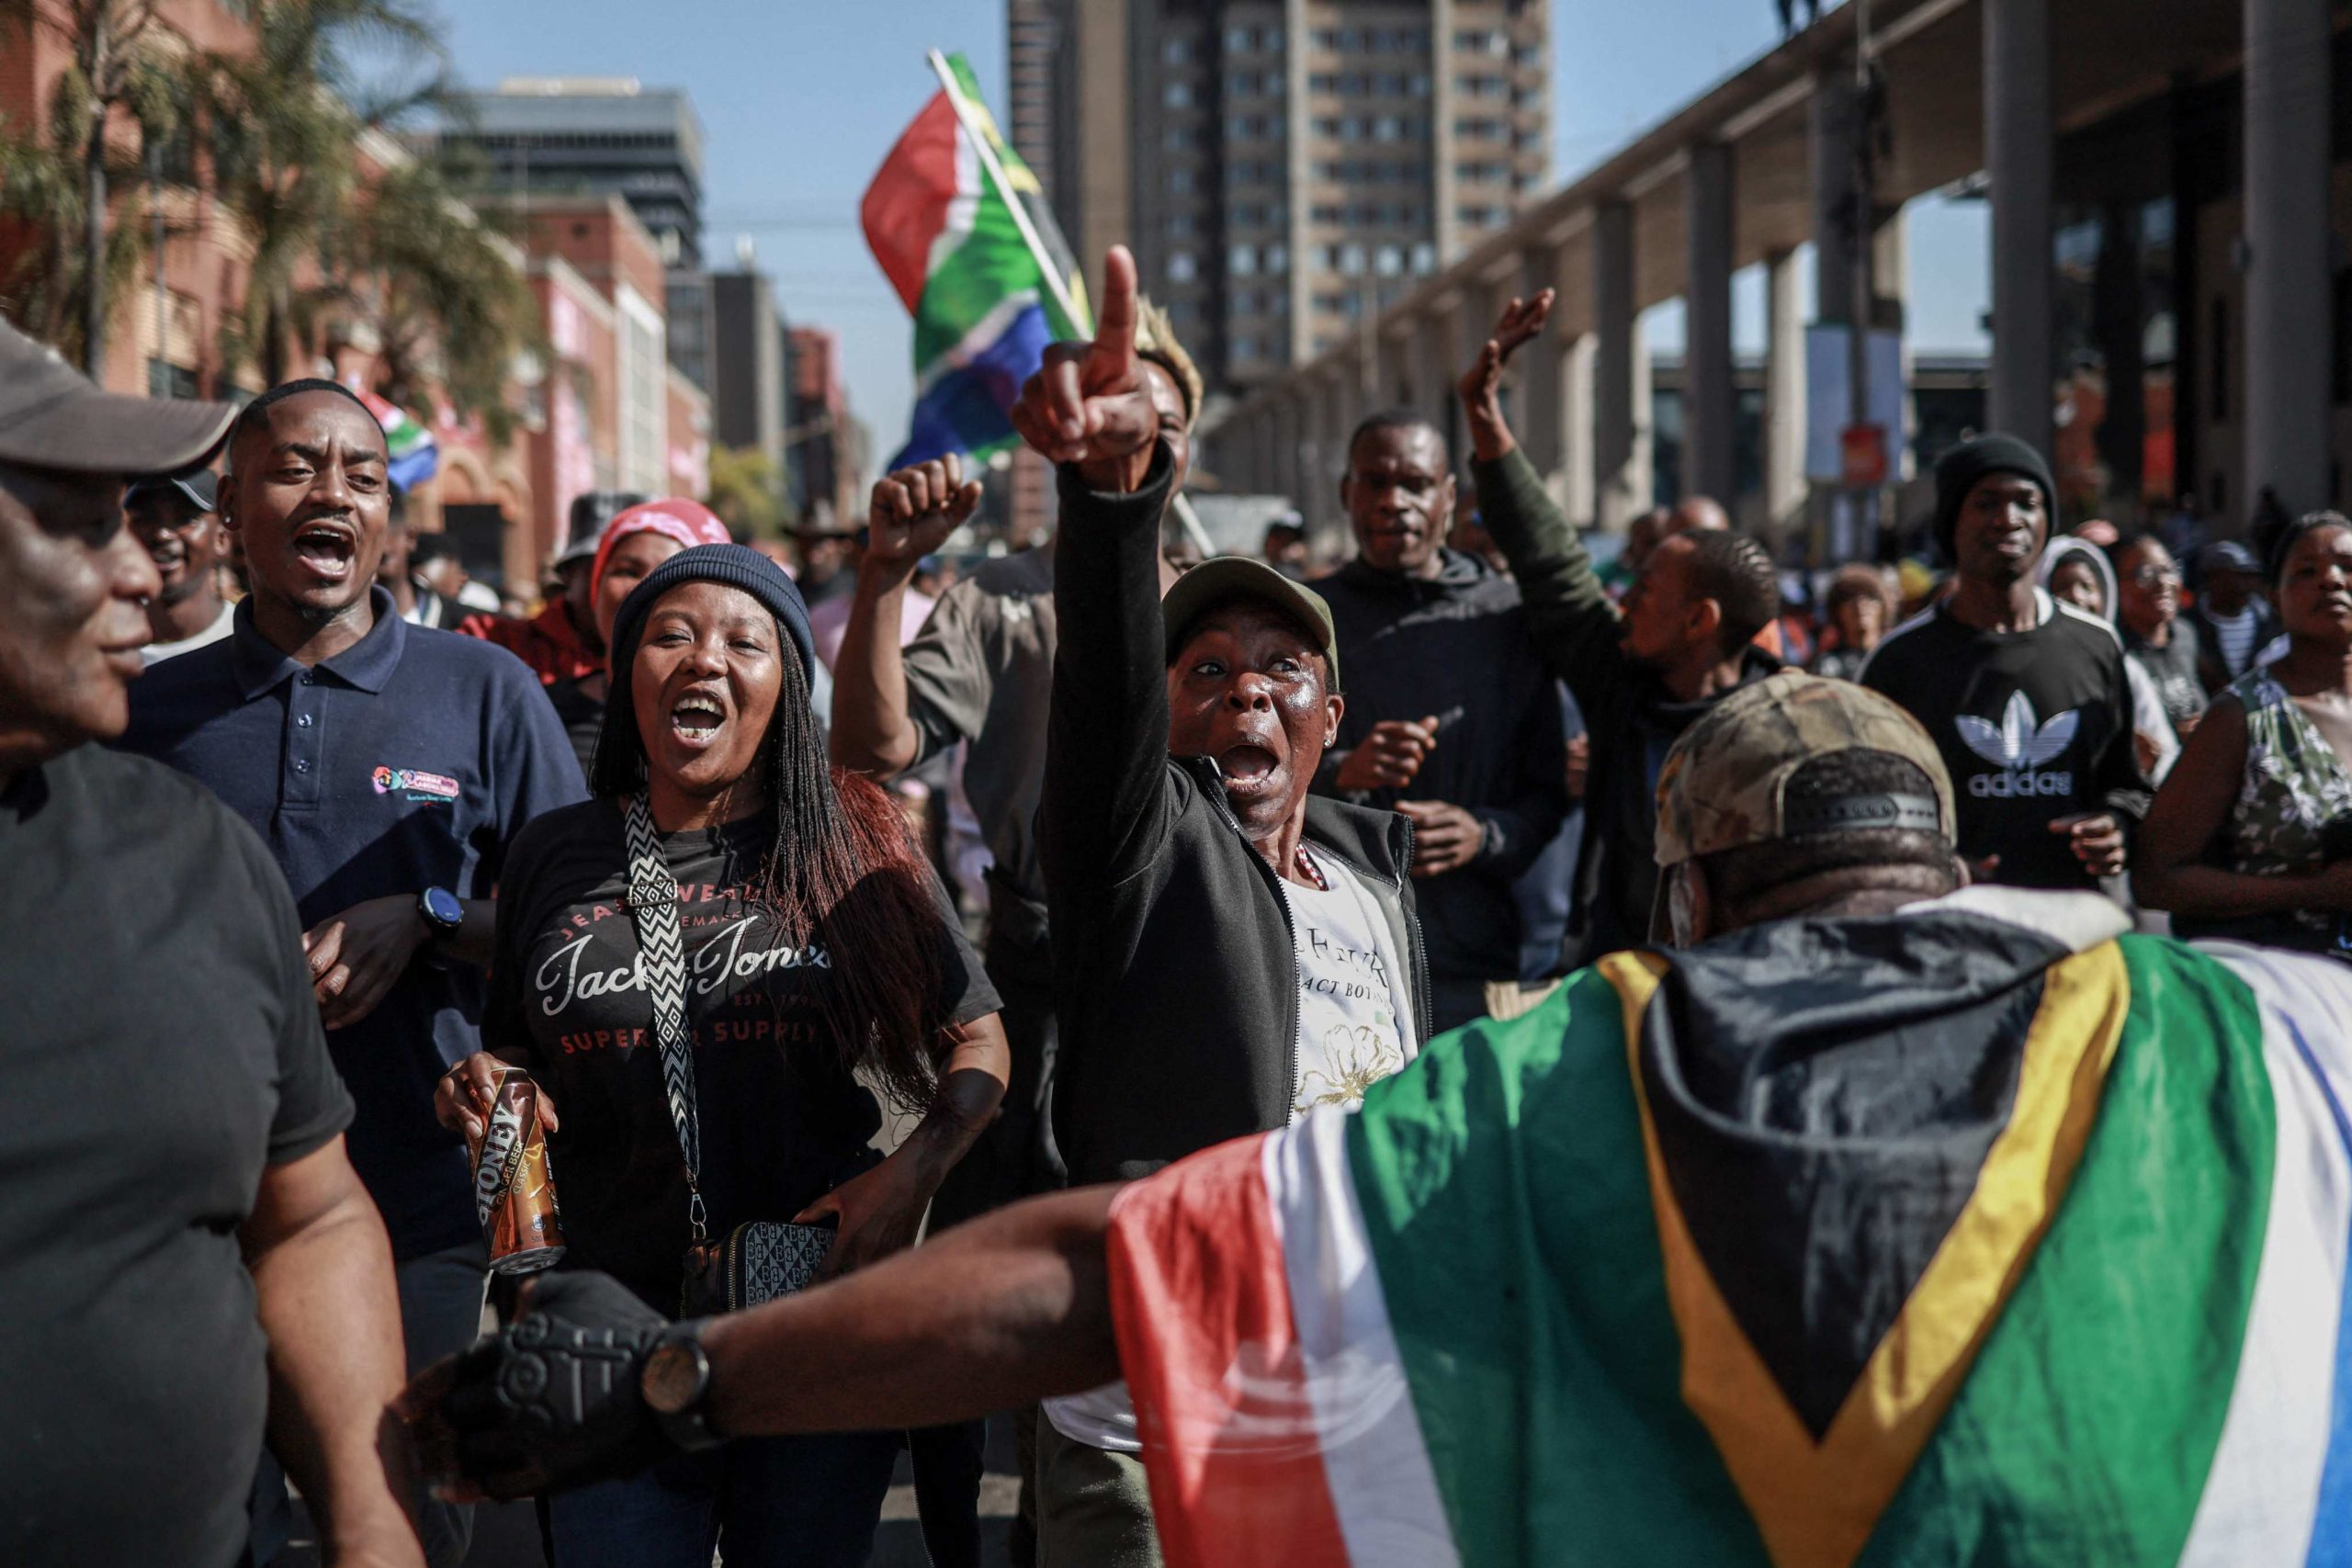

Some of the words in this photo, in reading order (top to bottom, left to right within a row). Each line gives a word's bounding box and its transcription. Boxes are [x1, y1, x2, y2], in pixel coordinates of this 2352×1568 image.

[560, 1027, 702, 1056] SUPERR
[713, 1021, 817, 1044] SUPPLY
[496, 1162, 515, 1206] GINGER
[508, 1142, 525, 1165] BEER
[513, 1159, 532, 1195] CLASSIC
